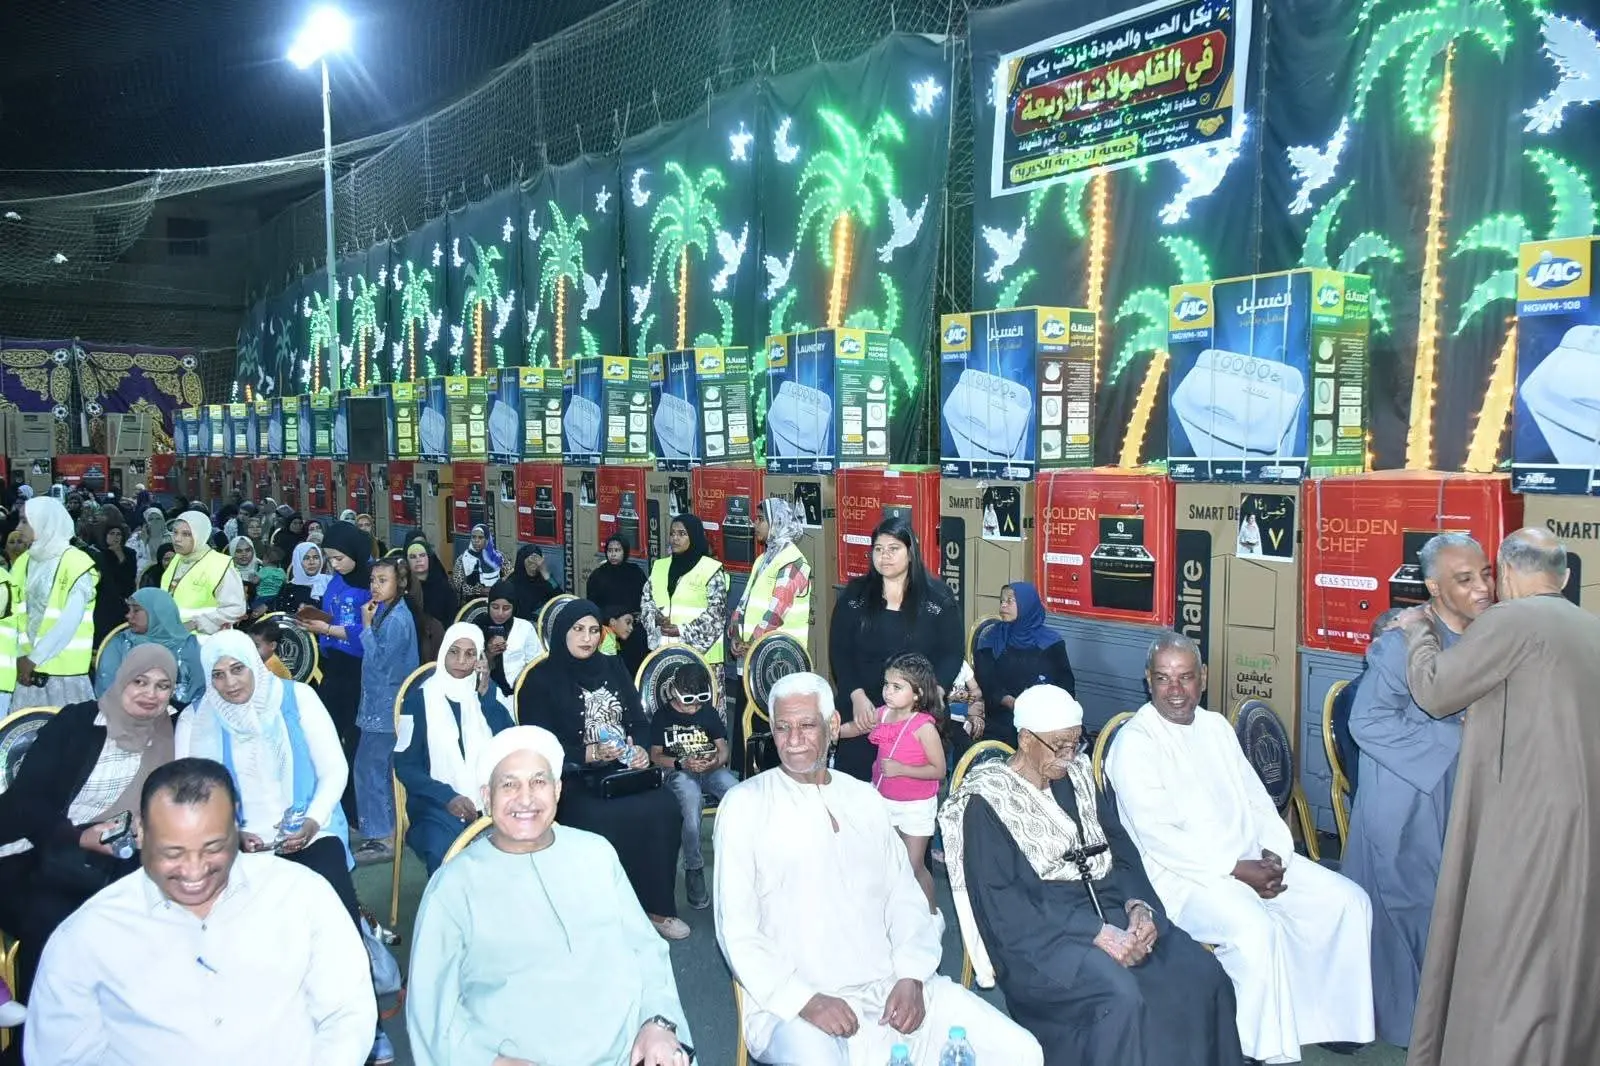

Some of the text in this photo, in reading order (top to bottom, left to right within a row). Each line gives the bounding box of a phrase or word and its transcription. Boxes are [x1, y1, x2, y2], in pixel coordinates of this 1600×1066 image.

[1182, 5, 1212, 34] بكل
[1144, 13, 1180, 45] الحب
[1090, 28, 1141, 58] والمودة
[1026, 59, 1050, 86] بكم
[1185, 37, 1213, 91] في
[1525, 261, 1582, 288] JAC
[1174, 299, 1208, 321] JAC
[1523, 301, 1581, 312] NGWM-108
[943, 327, 967, 343] JAC
[842, 496, 880, 509] GOLDEN
[949, 496, 973, 509] SMART
[1043, 507, 1096, 520] GOLDEN
[1189, 504, 1224, 520] SMART
[1003, 513, 1014, 532] ٨
[1043, 522, 1077, 535] CHEF
[1316, 518, 1398, 535] GOLDEN
[1547, 519, 1600, 539] SMART
[1268, 527, 1284, 551] ٧
[1316, 536, 1368, 552] CHEF
[942, 541, 960, 594] aire
[1319, 576, 1373, 588] GAS STOVE
[1236, 670, 1273, 684] عايشين
